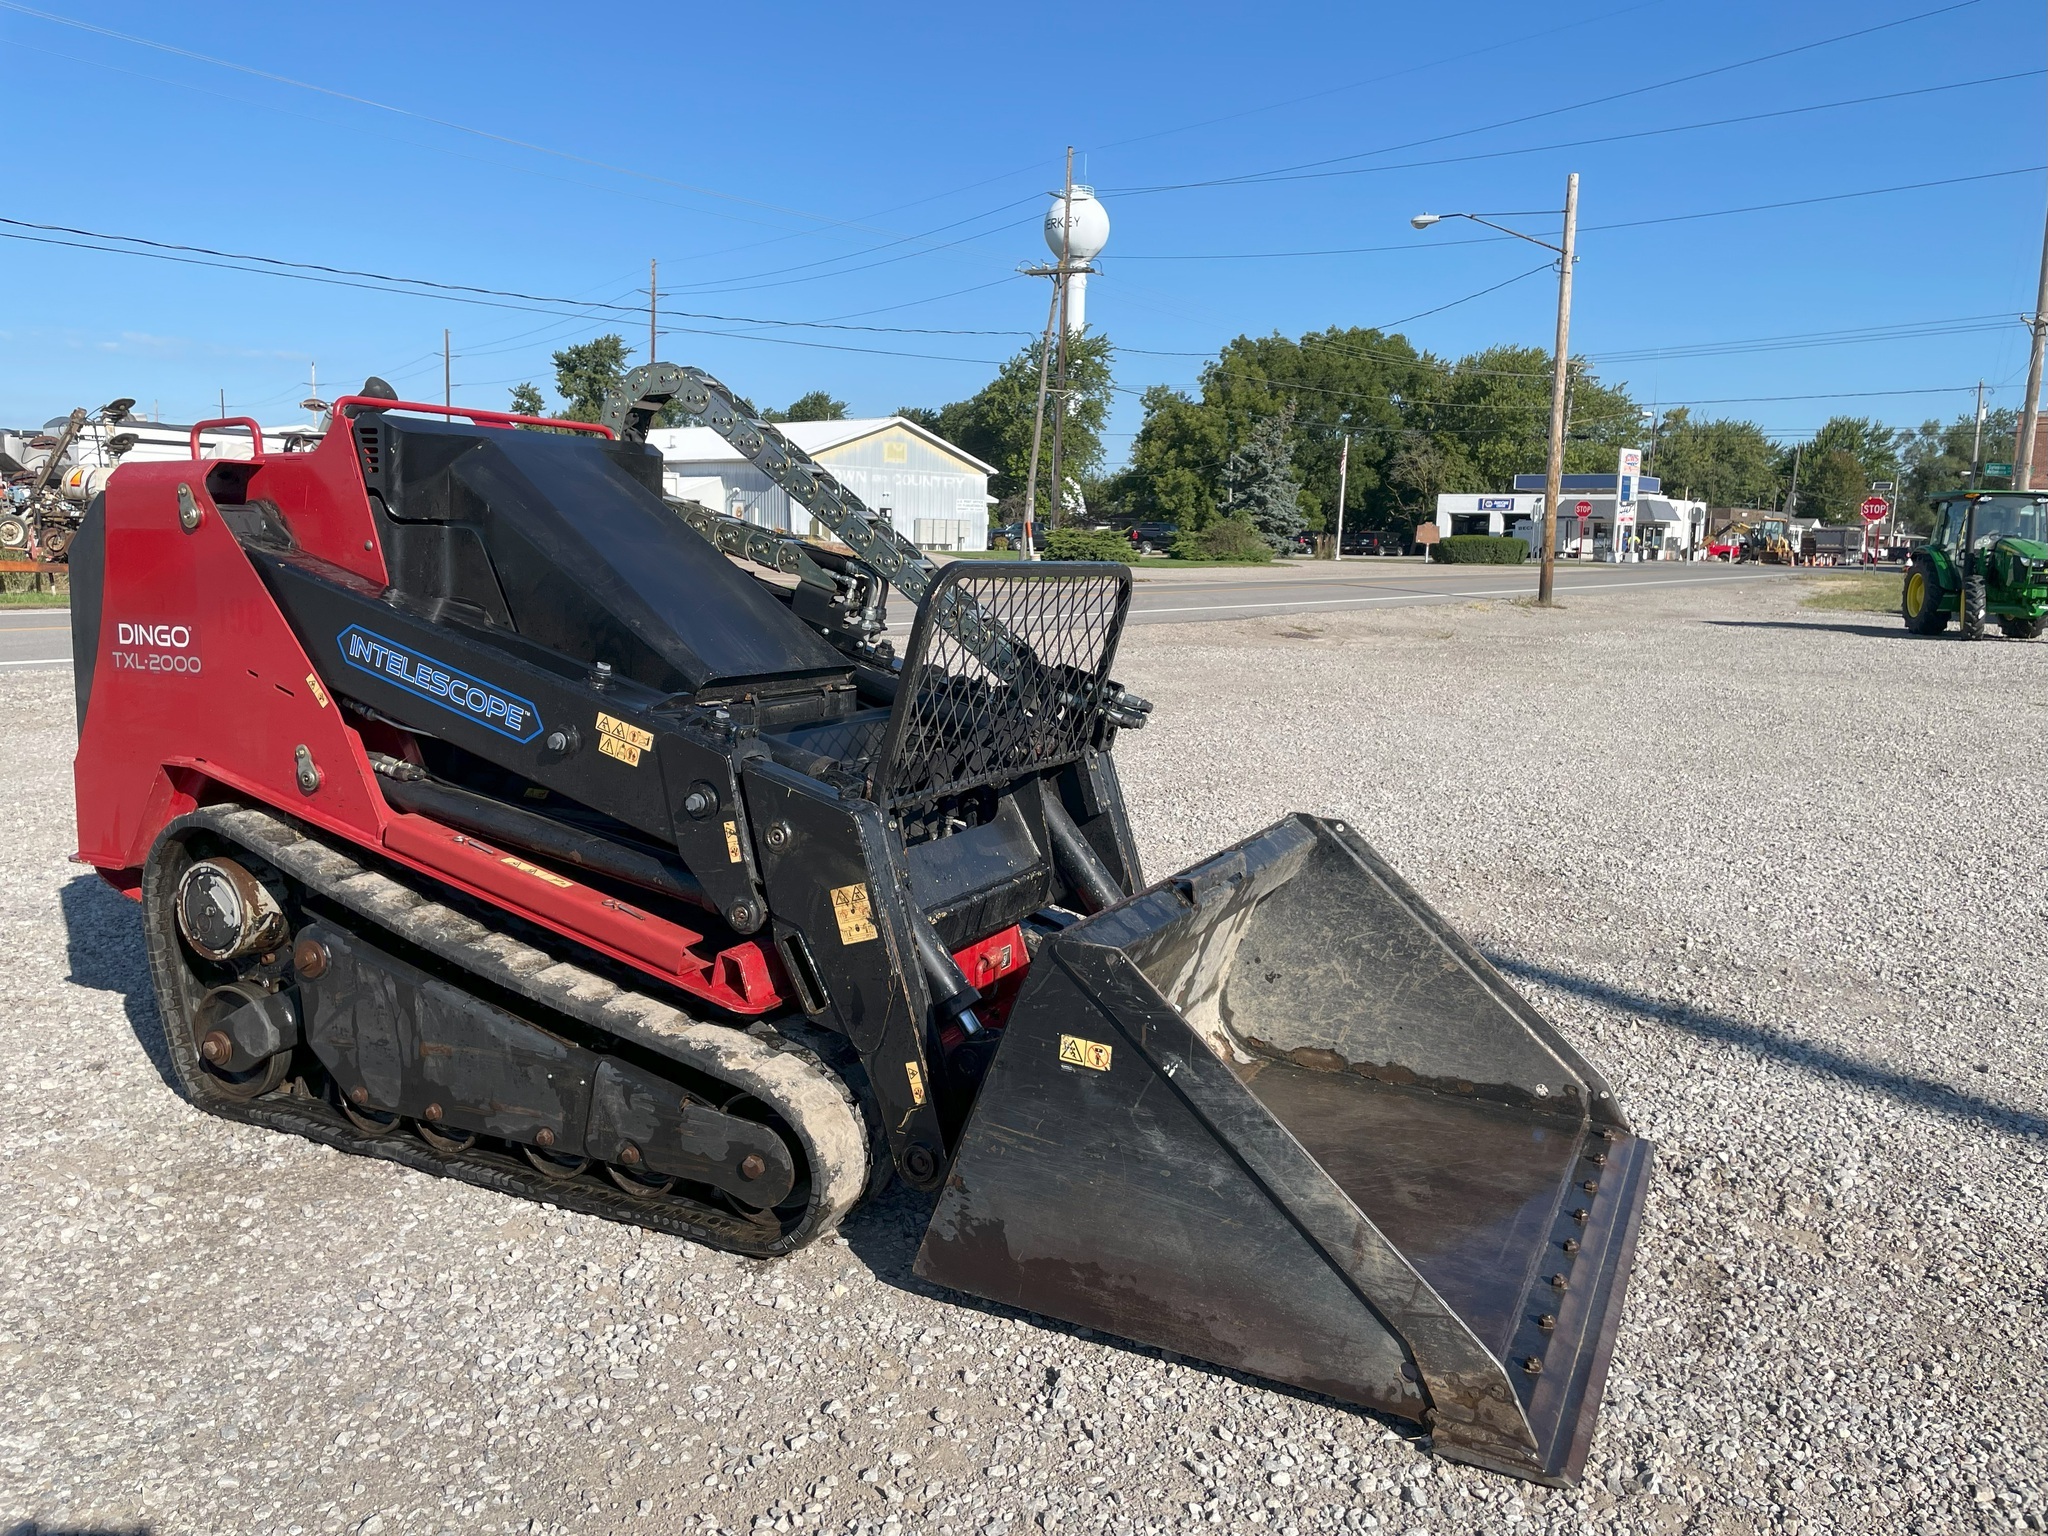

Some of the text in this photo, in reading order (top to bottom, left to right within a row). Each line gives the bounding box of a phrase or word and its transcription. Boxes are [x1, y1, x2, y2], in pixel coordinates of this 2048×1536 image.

[1045, 216, 1080, 231] ERKEY
[1576, 505, 1592, 513] STOP
[1863, 504, 1887, 514] STOP
